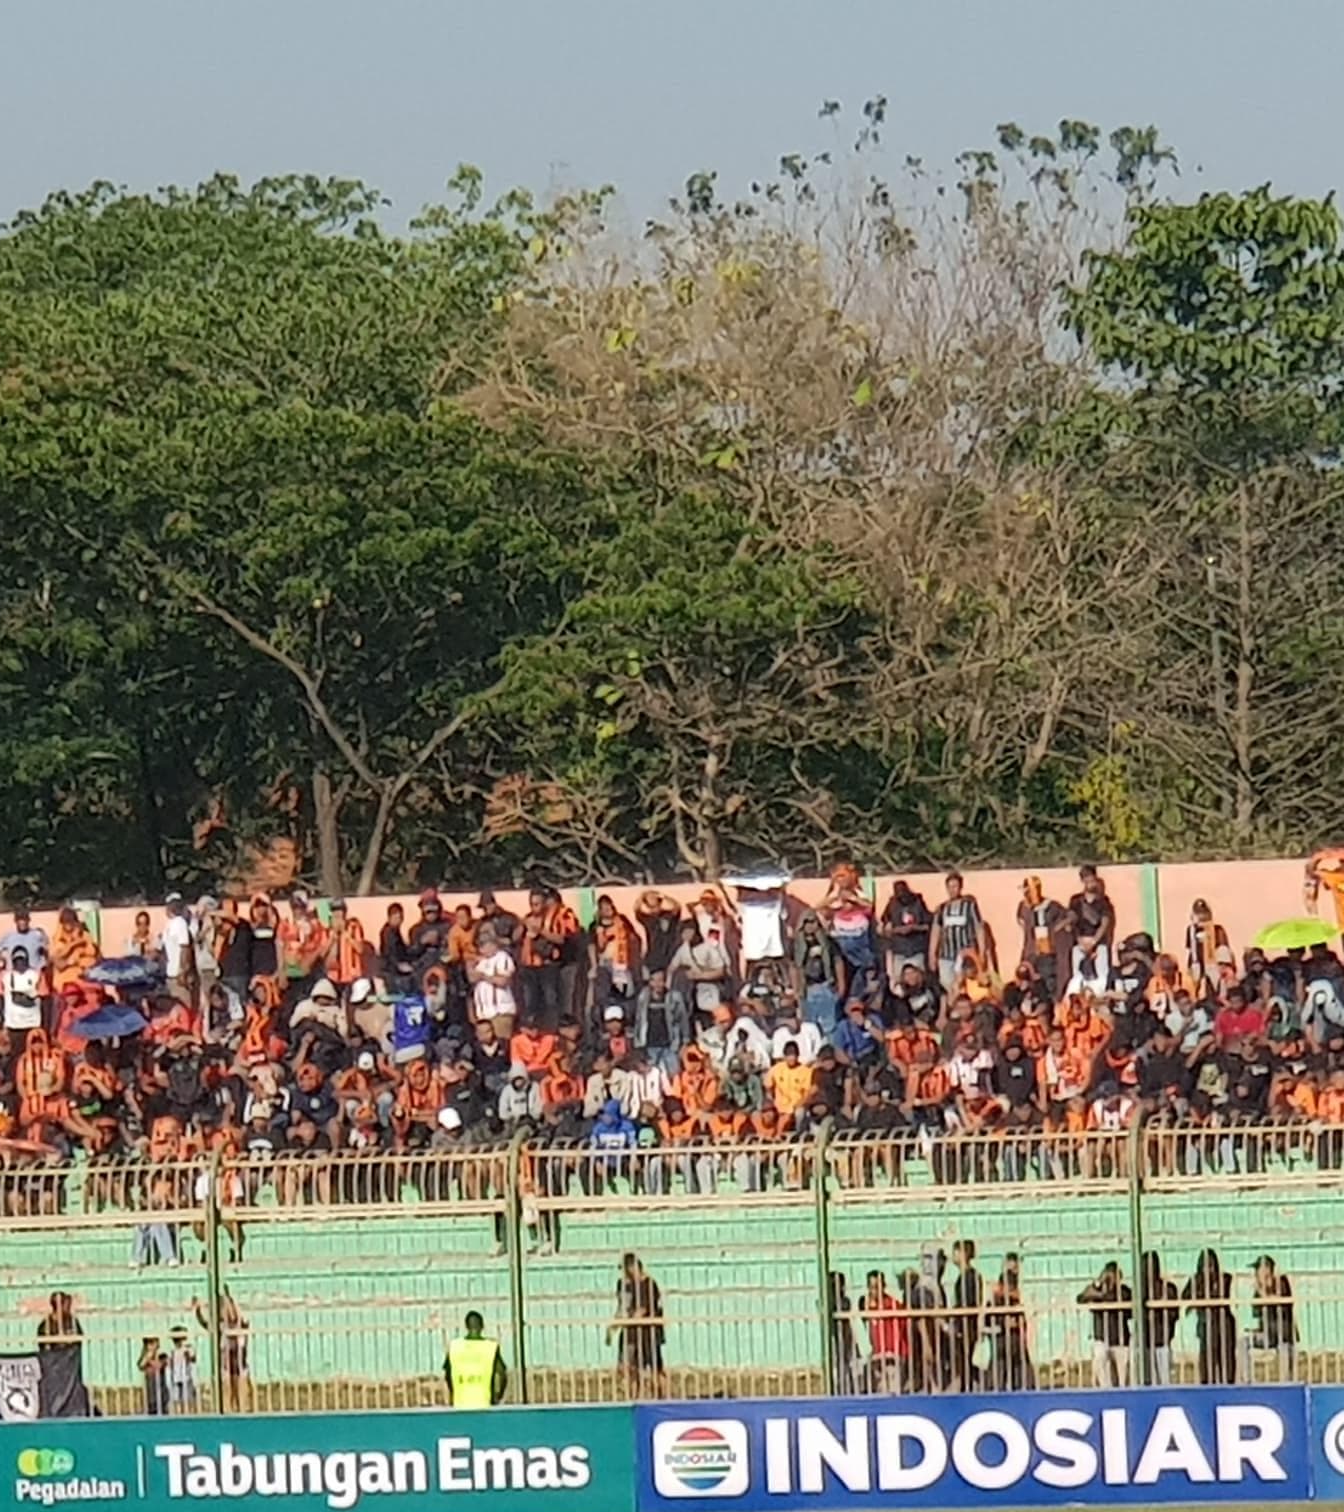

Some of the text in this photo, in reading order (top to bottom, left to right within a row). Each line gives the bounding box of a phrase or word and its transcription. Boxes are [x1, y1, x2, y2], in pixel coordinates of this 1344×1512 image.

[155, 1437, 592, 1509] Tabungan Emas
[763, 1405, 1288, 1495] INDOSIAR
[16, 1477, 125, 1505] Pegadaian
